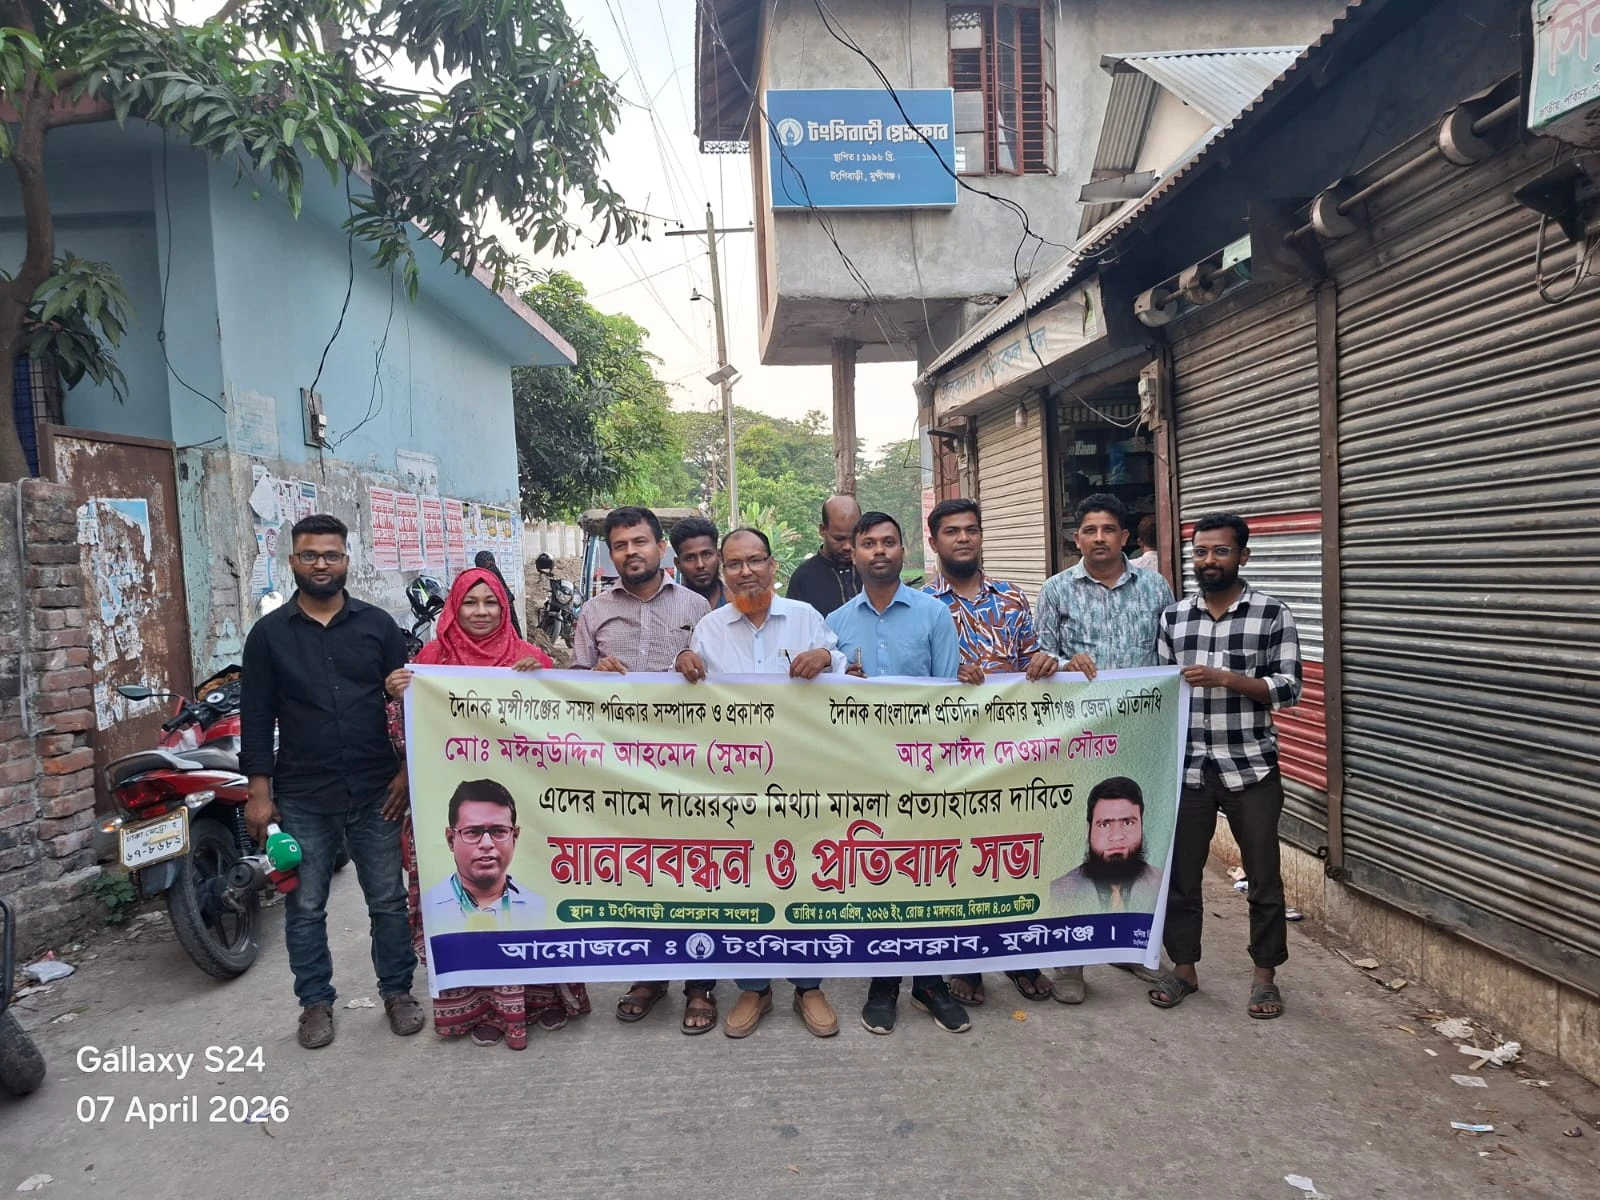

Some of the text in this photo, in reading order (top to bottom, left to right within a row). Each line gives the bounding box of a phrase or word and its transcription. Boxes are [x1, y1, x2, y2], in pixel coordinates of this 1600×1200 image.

[807, 119, 883, 145] টংগিবাড়ী
[449, 689, 774, 725] দৈনিক মুন্সীগঞ্জের সময় পত্রিকার সম্পাদক ও প্রকাশক
[829, 687, 1163, 727] দৈনিক বাংলাদেশ প্রতিদিন পত্রিকার মুন্সীগঞ্জ জেলা প্রতিনিধি
[445, 732, 774, 775] মোঃ মঈনুউদ্দিন আহমেদ (সুমন)
[896, 728, 1119, 773] আবু সাঈদ দেওয়ান সৌরভ
[539, 777, 1074, 829] এদের নামে দায়েরকৃত মিথ্যা মামলা প্রত্যাহারের দাবিতে
[546, 819, 1045, 893] মানববন্ধন ও প্রতিবাদ সভা
[568, 904, 594, 921] স্থান
[607, 903, 665, 921] টংগিবাড়ী
[669, 906, 720, 922] প্রেসক্লাব
[724, 907, 760, 923] সংলগ্ন
[791, 903, 816, 920] তারিখ
[825, 908, 837, 920] ০৭
[839, 903, 864, 922] এপ্রিল,
[866, 907, 889, 921] ২০২৬
[890, 904, 903, 922] ইং,
[905, 905, 924, 919] রোজ
[932, 903, 966, 919] মঙ্গলবার,
[968, 900, 991, 916] বিকাল
[992, 902, 1011, 914] ৪.০০
[1013, 896, 1035, 912] ঘটিকা
[497, 938, 652, 961] আয়োজনে
[721, 933, 855, 959] টংগিবাড়ী
[866, 934, 990, 956] প্রেসক্লাব,
[998, 924, 1095, 952] মুন্সীগঞ্জ
